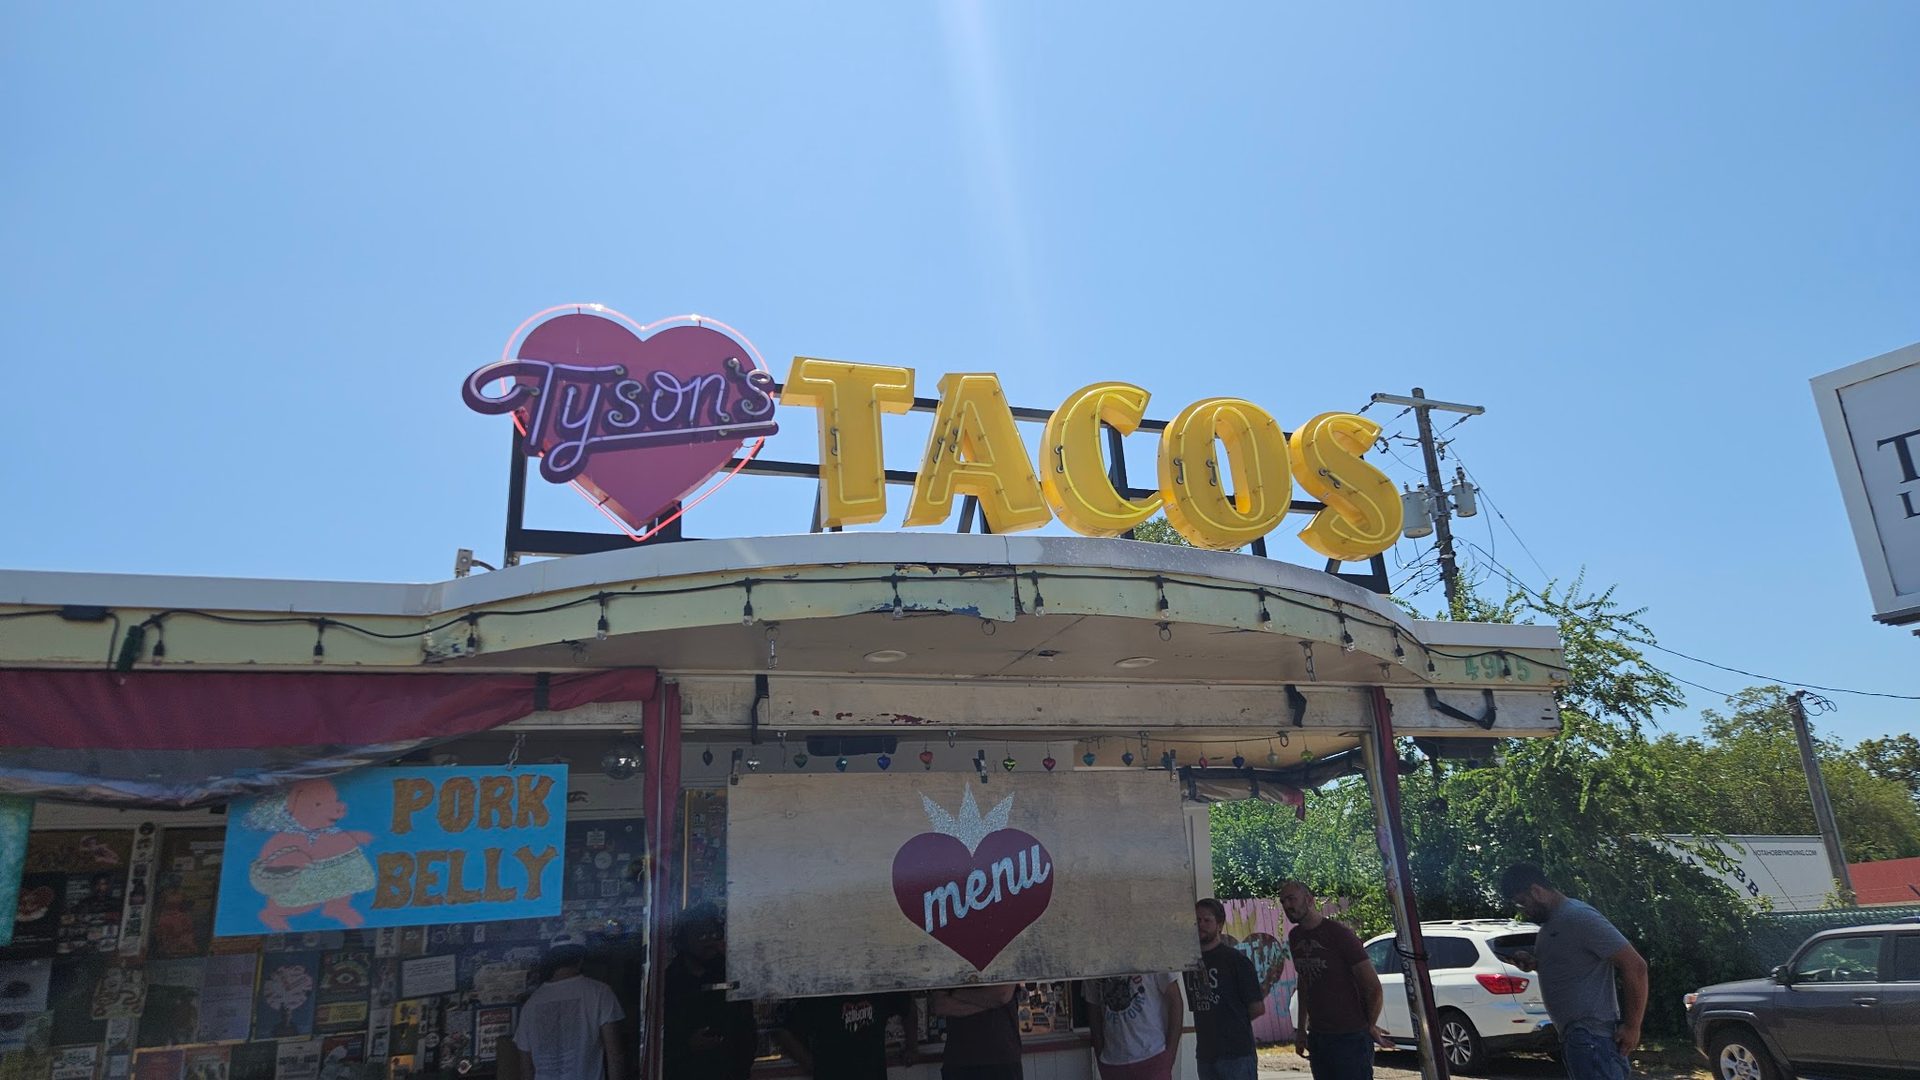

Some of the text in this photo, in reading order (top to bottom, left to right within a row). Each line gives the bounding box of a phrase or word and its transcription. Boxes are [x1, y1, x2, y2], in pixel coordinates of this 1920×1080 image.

[462, 356, 1404, 562] Tyson's TACOS
[390, 774, 556, 835] PORK
[371, 845, 560, 910] BELLY
[923, 844, 1051, 934] menu
